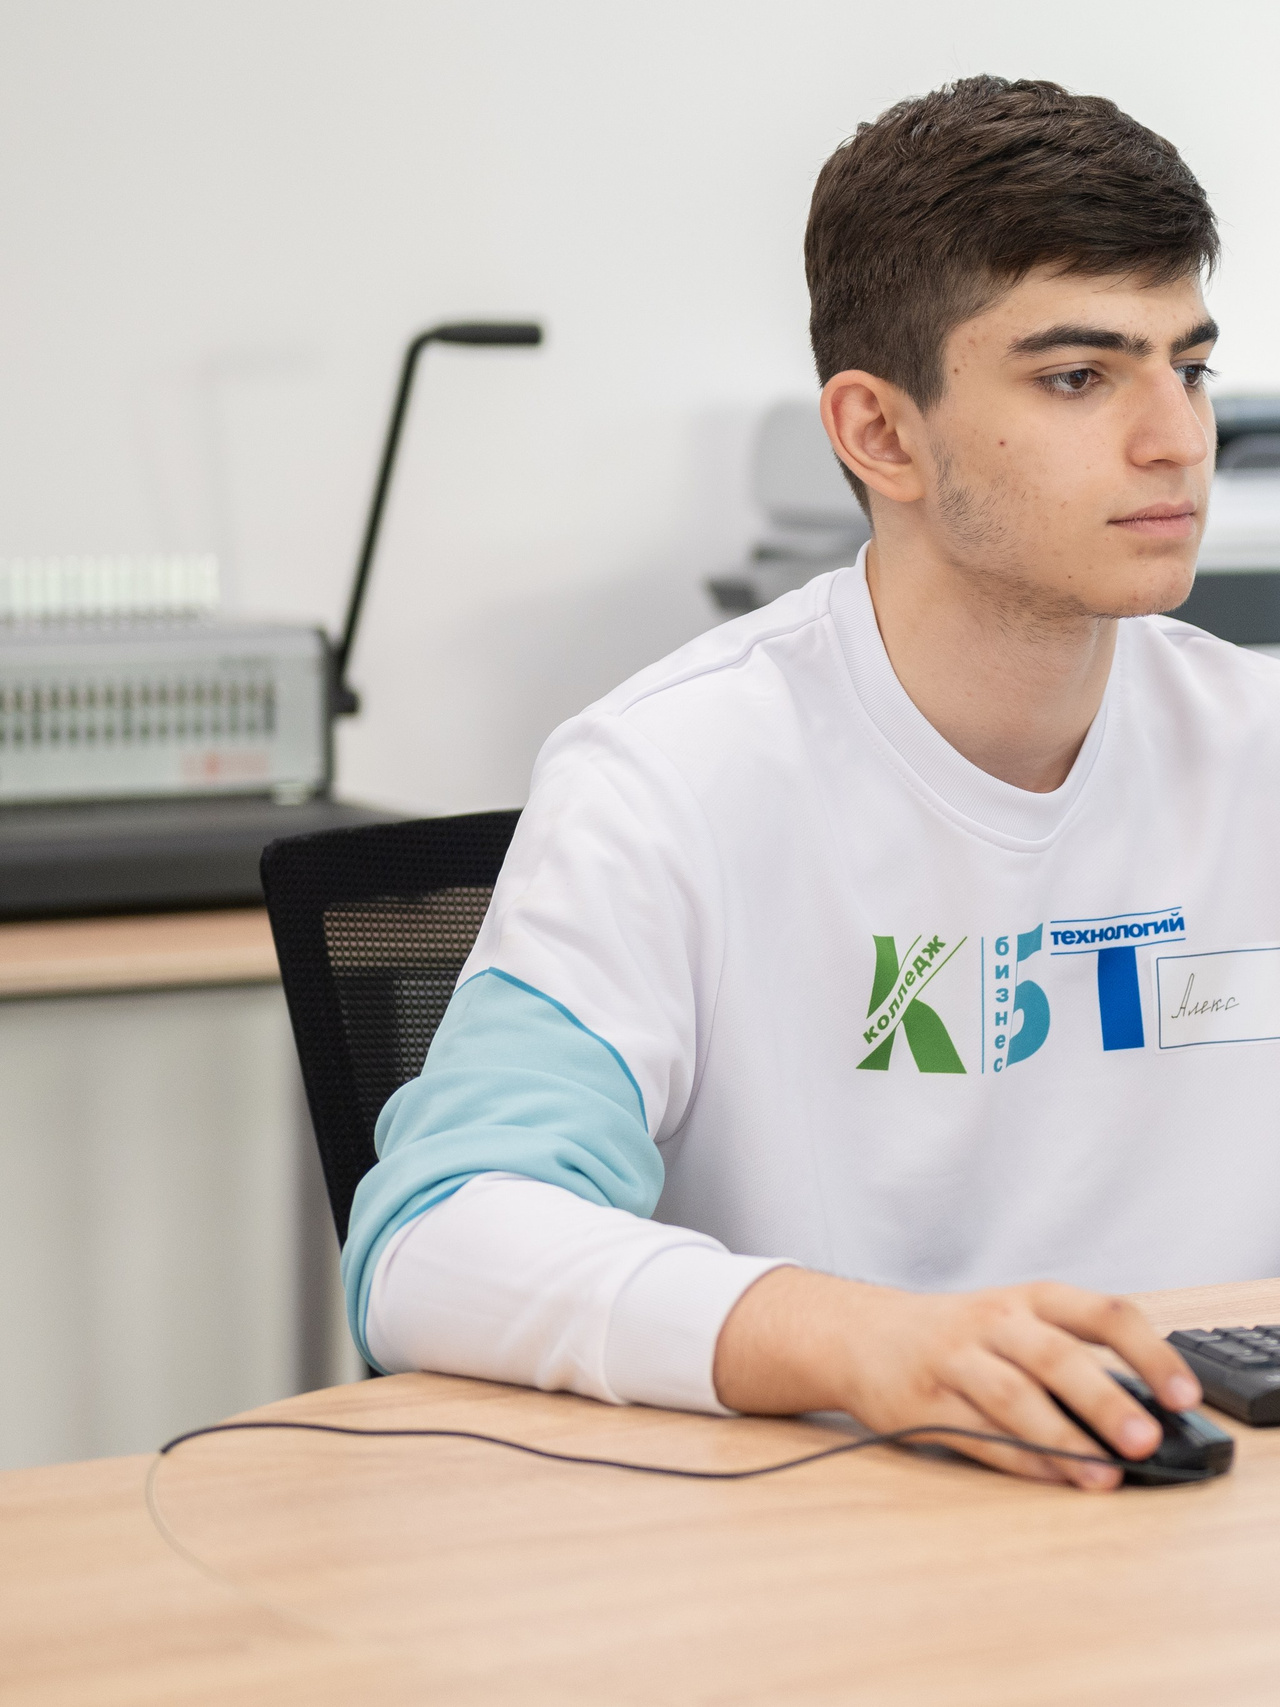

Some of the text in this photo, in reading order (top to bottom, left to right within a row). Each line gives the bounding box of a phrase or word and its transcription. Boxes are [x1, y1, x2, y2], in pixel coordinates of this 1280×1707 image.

[1049, 911, 1186, 946] технологий
[862, 934, 947, 1045] колледж
[993, 935, 1010, 1073] бизнес
[1170, 972, 1240, 1019] Алекс
